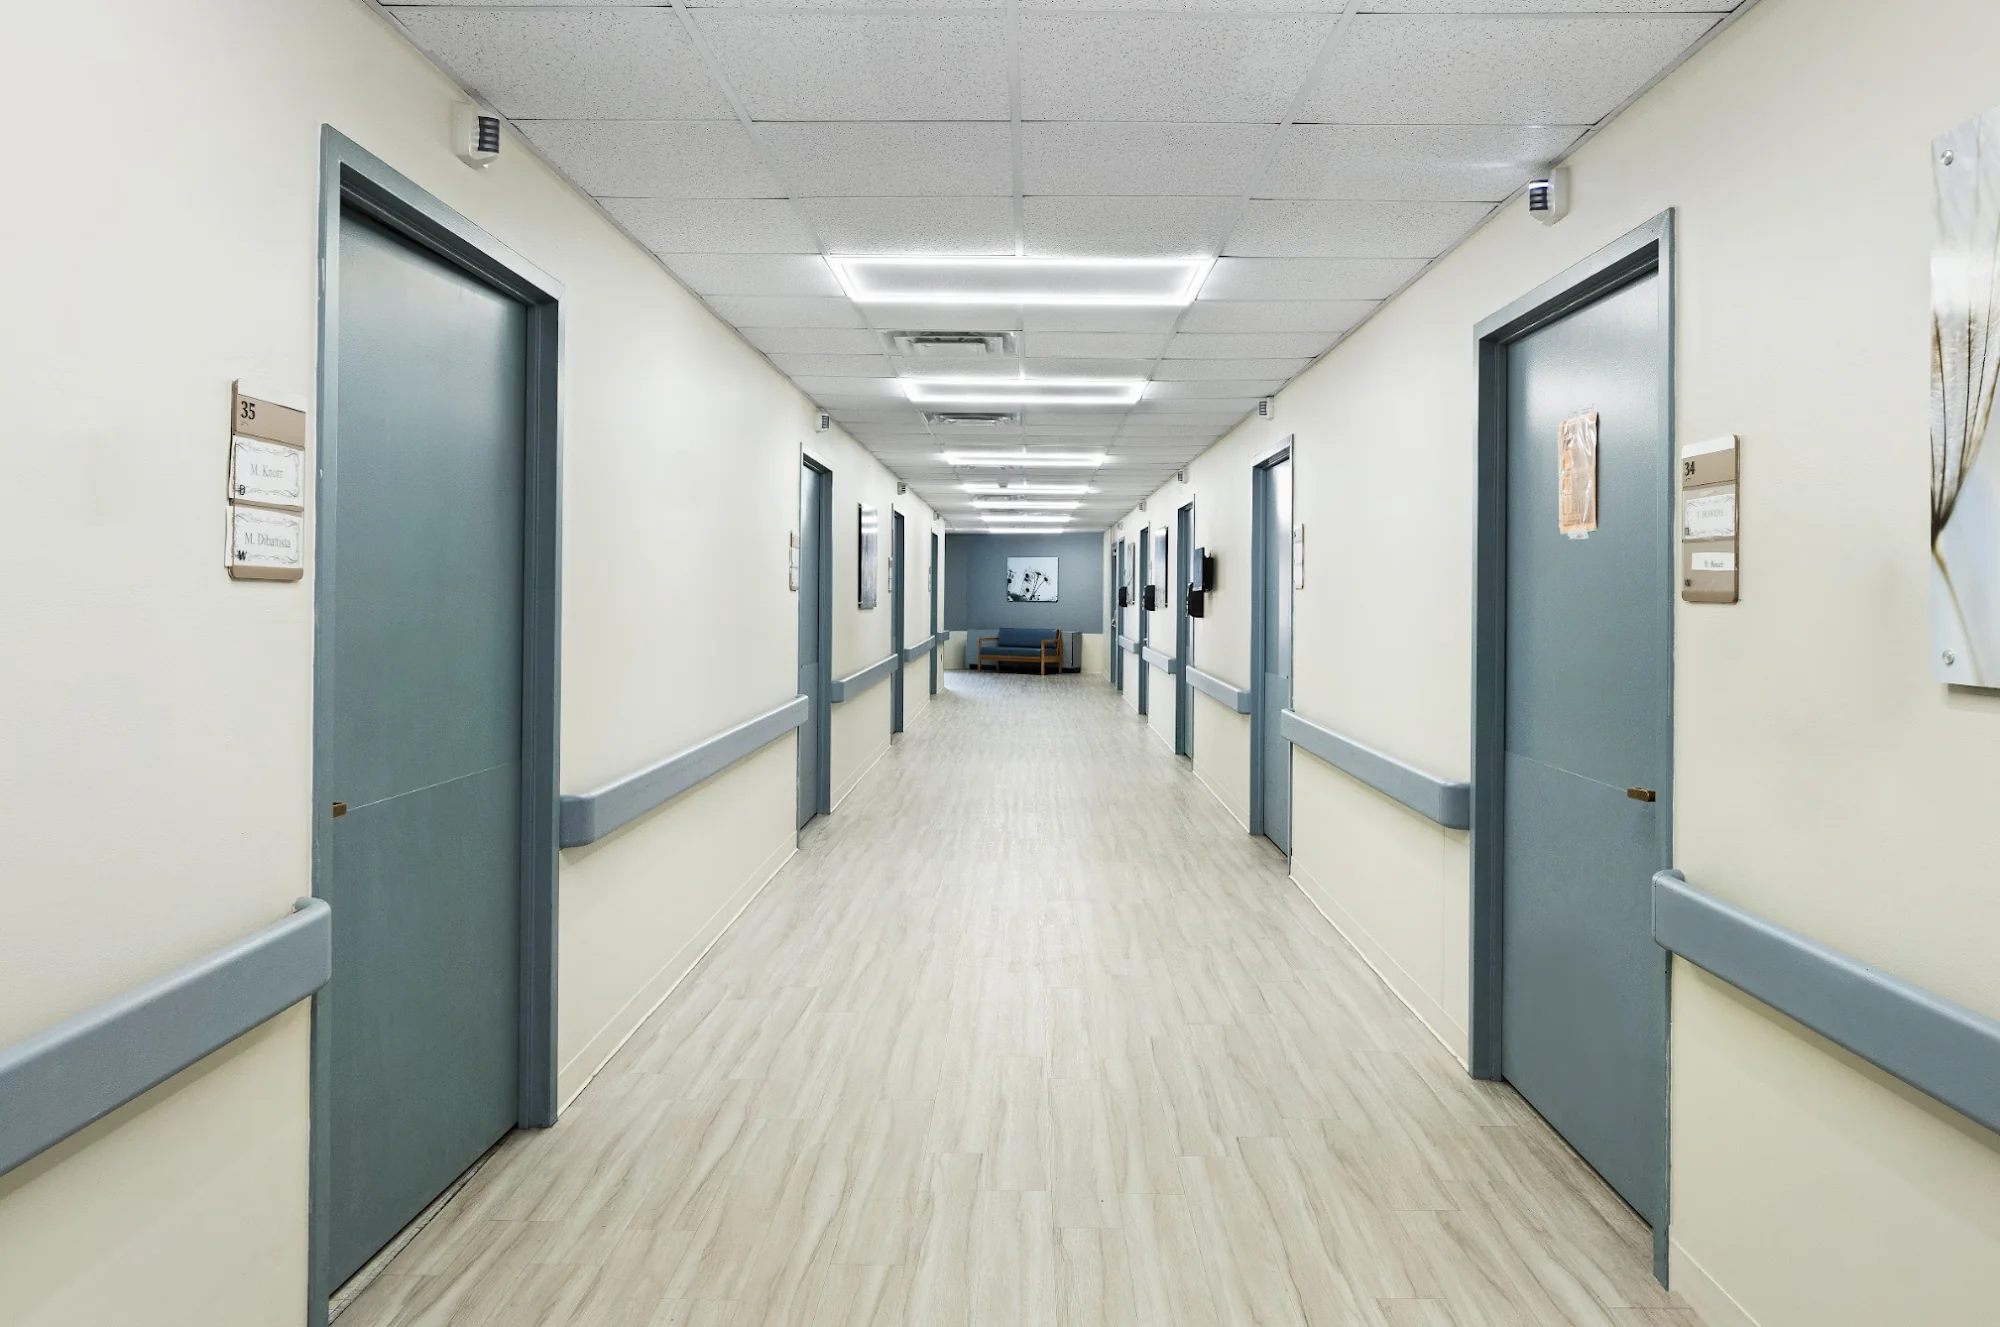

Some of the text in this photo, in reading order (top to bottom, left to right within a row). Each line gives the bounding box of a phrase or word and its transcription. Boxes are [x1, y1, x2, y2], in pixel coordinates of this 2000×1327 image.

[241, 401, 256, 420] 35
[250, 463, 260, 476] M.
[1684, 461, 1696, 476] 34
[244, 532, 256, 544] M.
